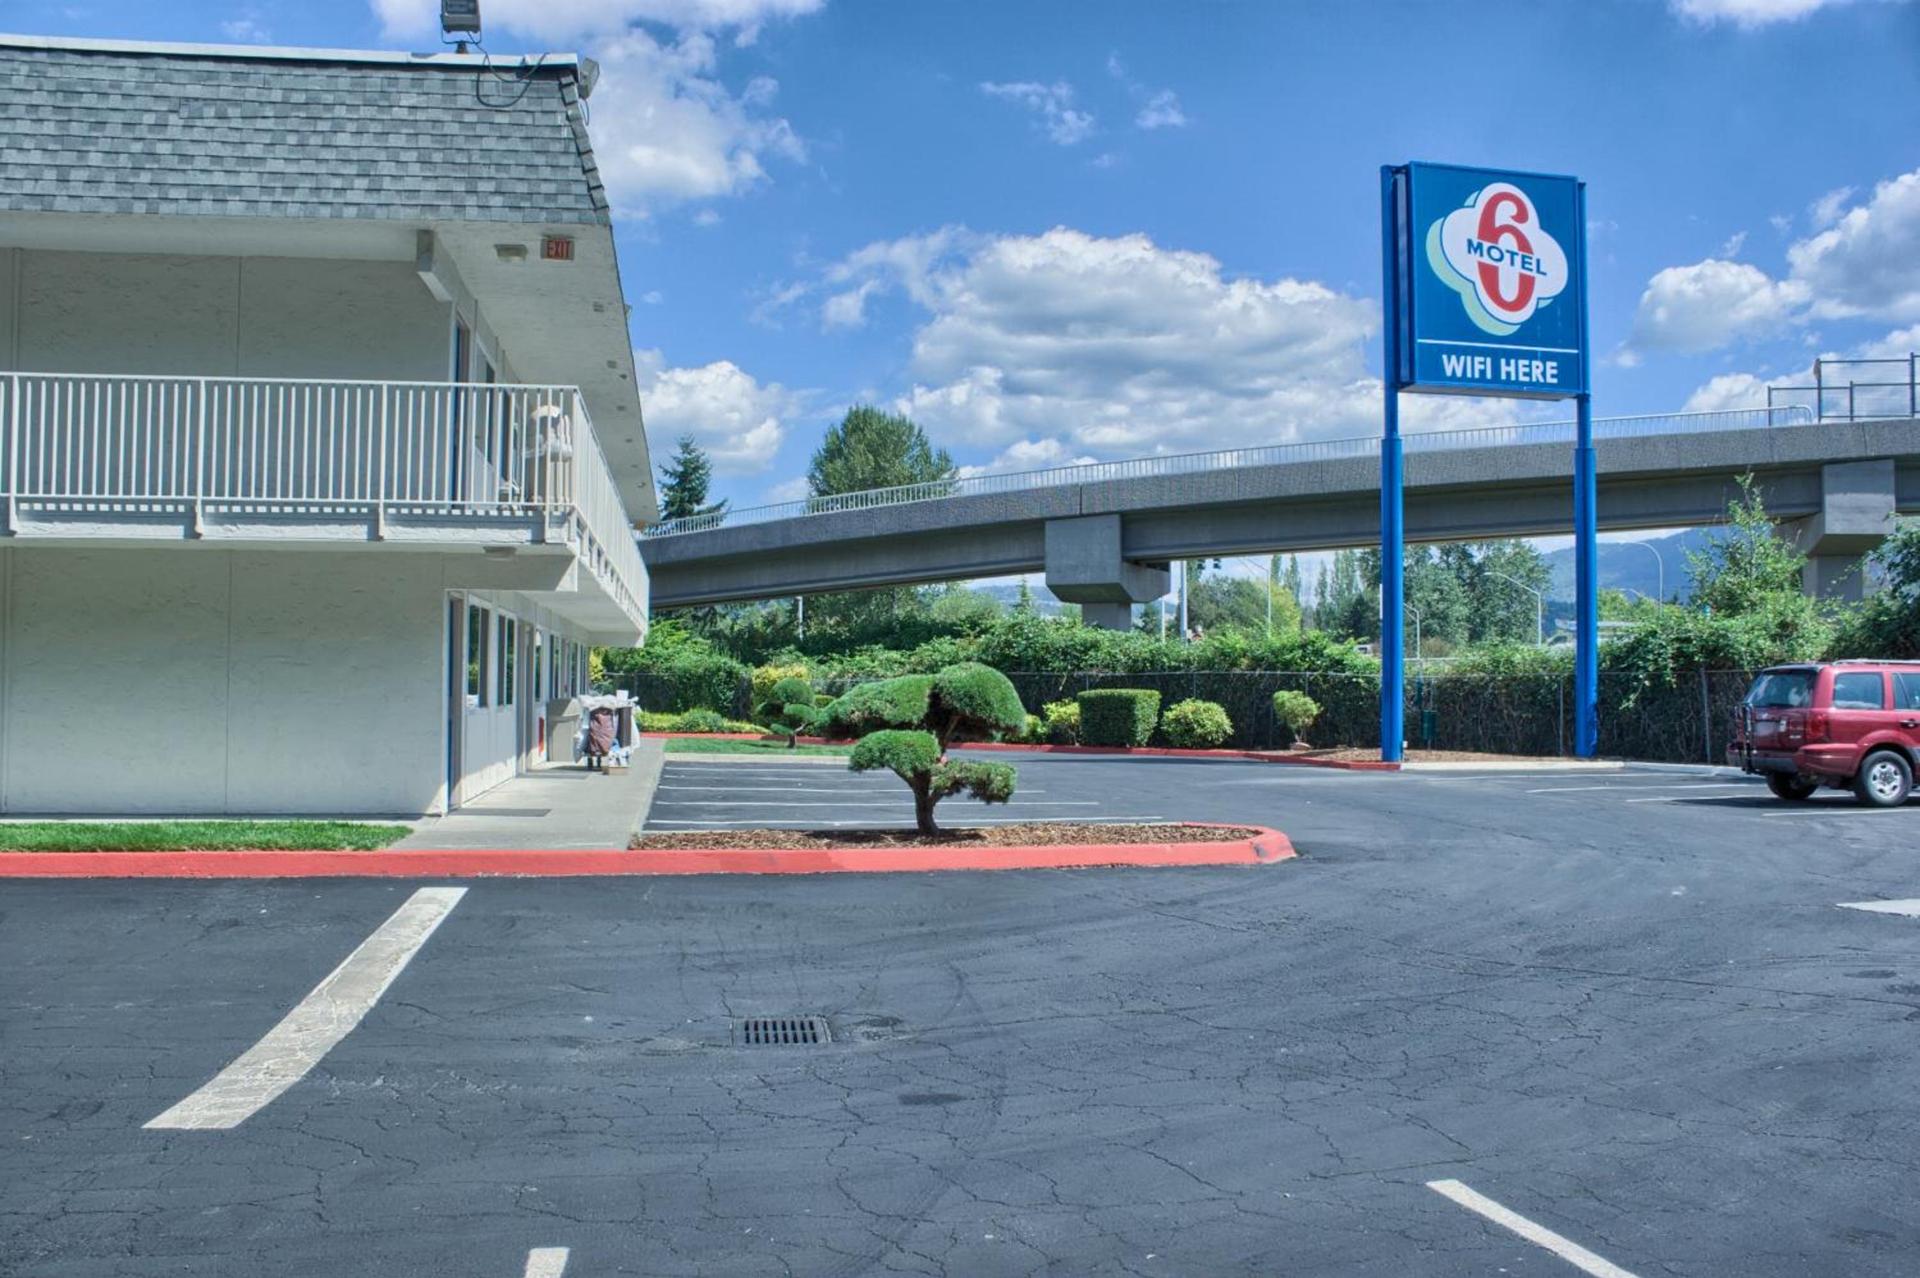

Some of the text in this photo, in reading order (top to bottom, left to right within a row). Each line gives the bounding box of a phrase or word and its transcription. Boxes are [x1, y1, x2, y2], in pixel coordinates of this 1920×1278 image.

[546, 240, 570, 258] EXIT
[1467, 239, 1547, 275] MOTEL
[1477, 192, 1535, 312] 6
[1443, 355, 1558, 383] WIFI HERE
